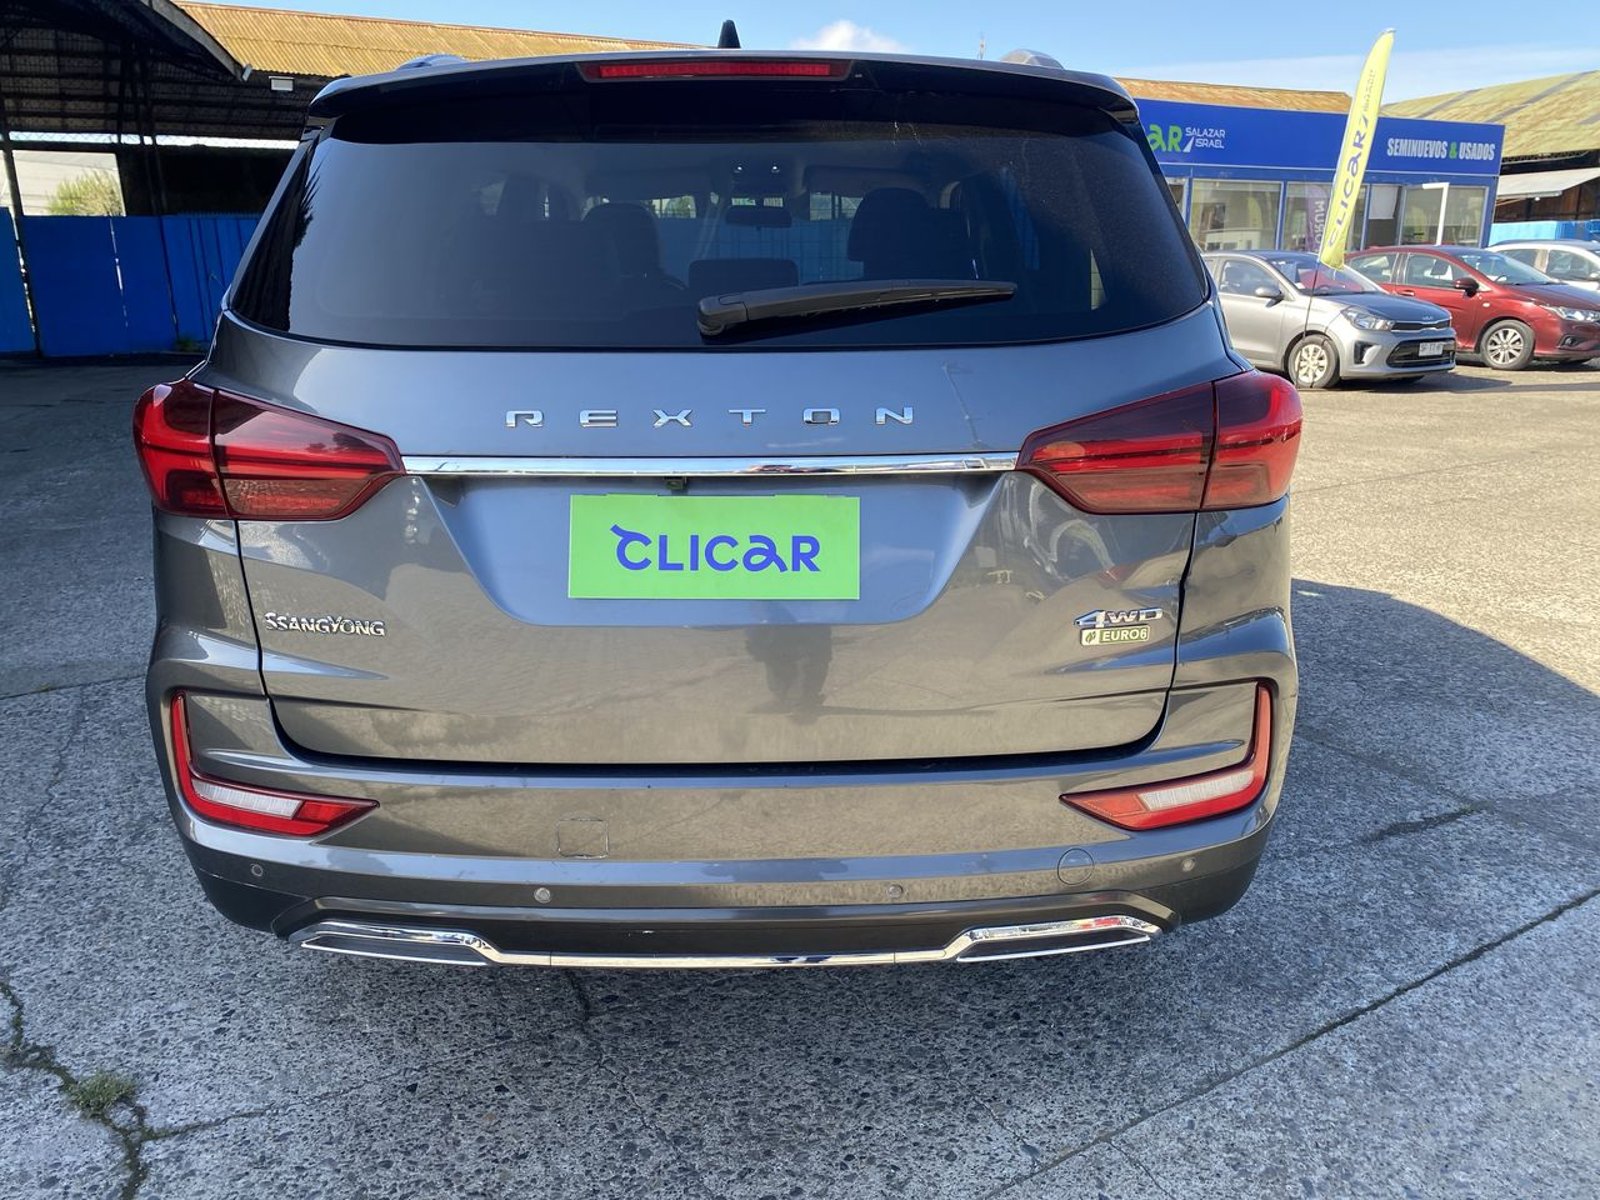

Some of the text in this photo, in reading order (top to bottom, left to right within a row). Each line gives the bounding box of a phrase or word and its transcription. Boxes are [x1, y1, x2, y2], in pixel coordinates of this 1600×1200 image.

[1185, 126, 1226, 138] SALAZAR
[1195, 138, 1225, 149] ISRAEL
[1387, 138, 1496, 160] SEMINUEVOS & USADOS
[504, 406, 915, 428] REXTON
[1074, 607, 1164, 628] 4WD
[1102, 628, 1148, 642] EURO6
